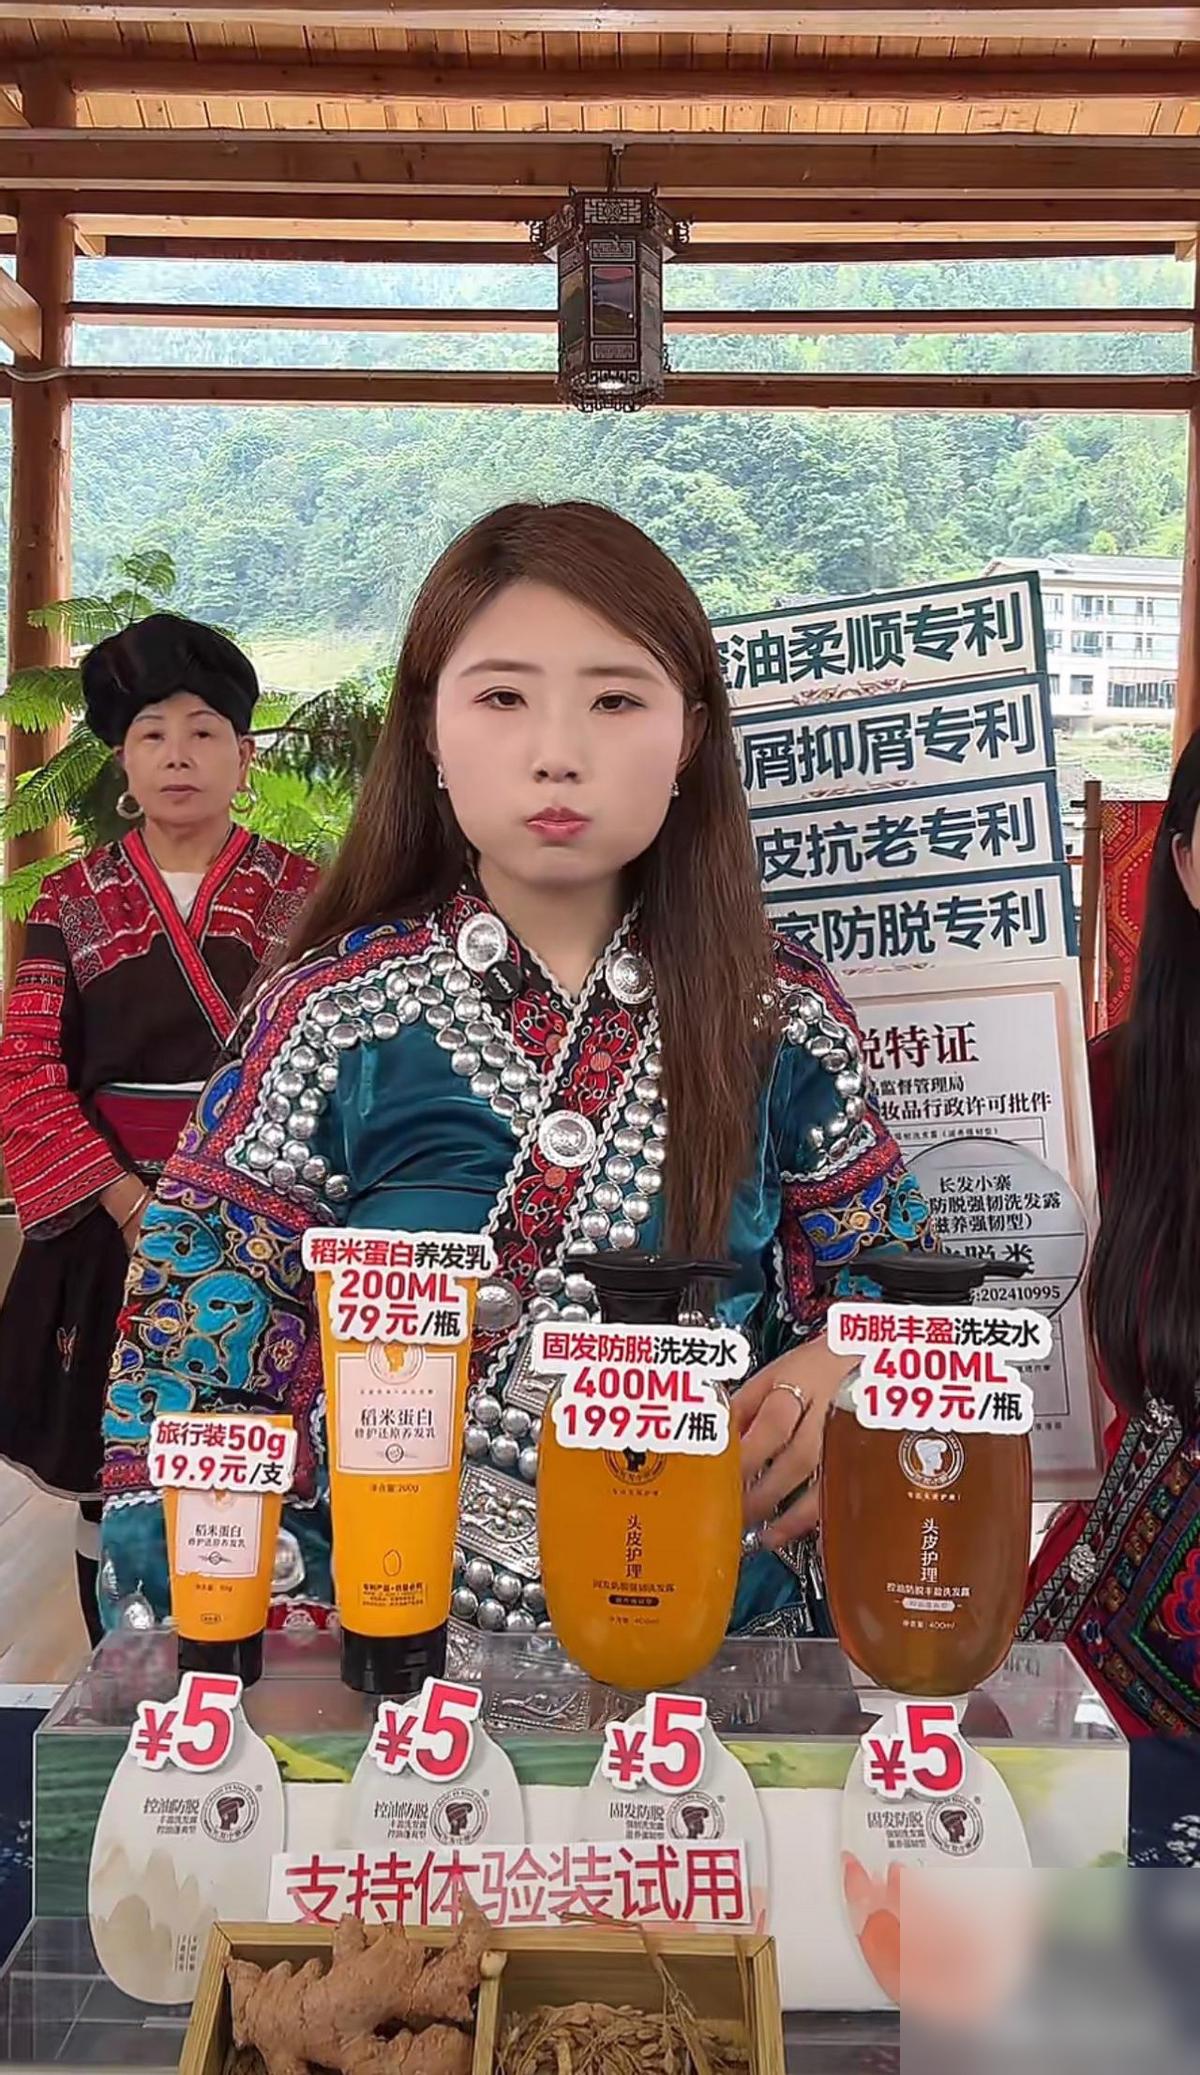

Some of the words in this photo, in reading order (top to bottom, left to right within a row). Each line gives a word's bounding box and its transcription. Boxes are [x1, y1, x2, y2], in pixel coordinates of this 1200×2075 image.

[743, 694, 1037, 791] 屑抑屑专利
[755, 796, 1036, 883] 皮抗老专利
[772, 888, 1047, 962] 家防脱专利
[881, 1093, 1052, 1121] 妆品行政许可批件
[929, 1192, 1061, 1214] 防脱强韧洗发露
[311, 1238, 491, 1271] 稻米蛋白养发乳
[340, 1269, 460, 1303] 200ML
[338, 1304, 460, 1337] 79元/瓶
[840, 1314, 1040, 1347] 防脱丰盈洗发水
[542, 1332, 737, 1367] 固发防脱洗发水
[873, 1348, 1008, 1383] 400ML
[573, 1367, 704, 1403] 400ML
[864, 1385, 1022, 1421] 199元/瓶
[361, 1408, 432, 1426] 稻米蛋白
[563, 1404, 717, 1441] 199元/瓶
[156, 1420, 286, 1460] 旅行装50g
[154, 1454, 284, 1486] 19.9元/支
[625, 1514, 643, 1579] 头皮护理
[920, 1517, 939, 1583] 头皮护理
[135, 1676, 239, 1766] ¥5
[375, 1682, 479, 1777] ¥5
[608, 1697, 703, 1787] ¥5
[868, 1705, 963, 1792] ¥5
[285, 1845, 742, 1926] 支持体验装试用
